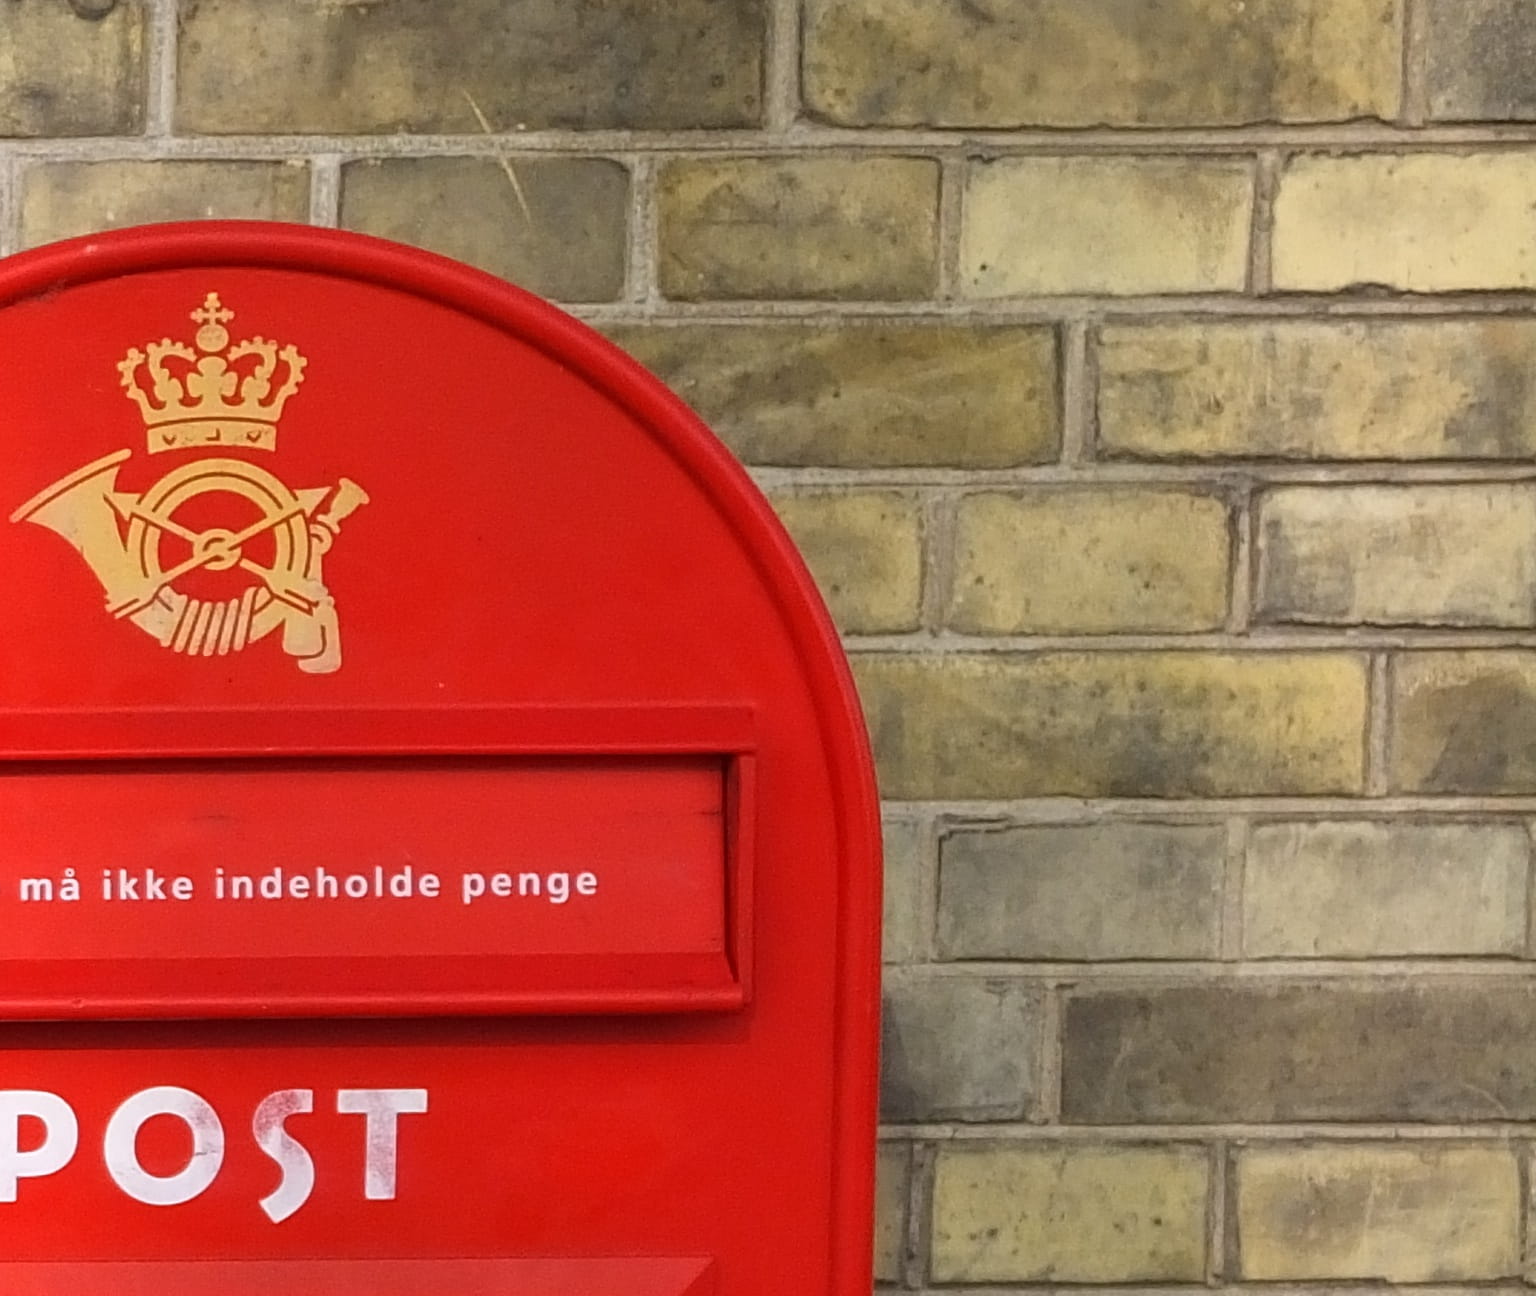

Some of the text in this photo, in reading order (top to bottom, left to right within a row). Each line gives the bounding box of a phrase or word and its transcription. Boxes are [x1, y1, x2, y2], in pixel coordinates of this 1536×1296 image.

[19, 870, 81, 902] må
[102, 869, 195, 901] ikke
[215, 867, 442, 900] indeholde
[461, 868, 600, 906] penge
